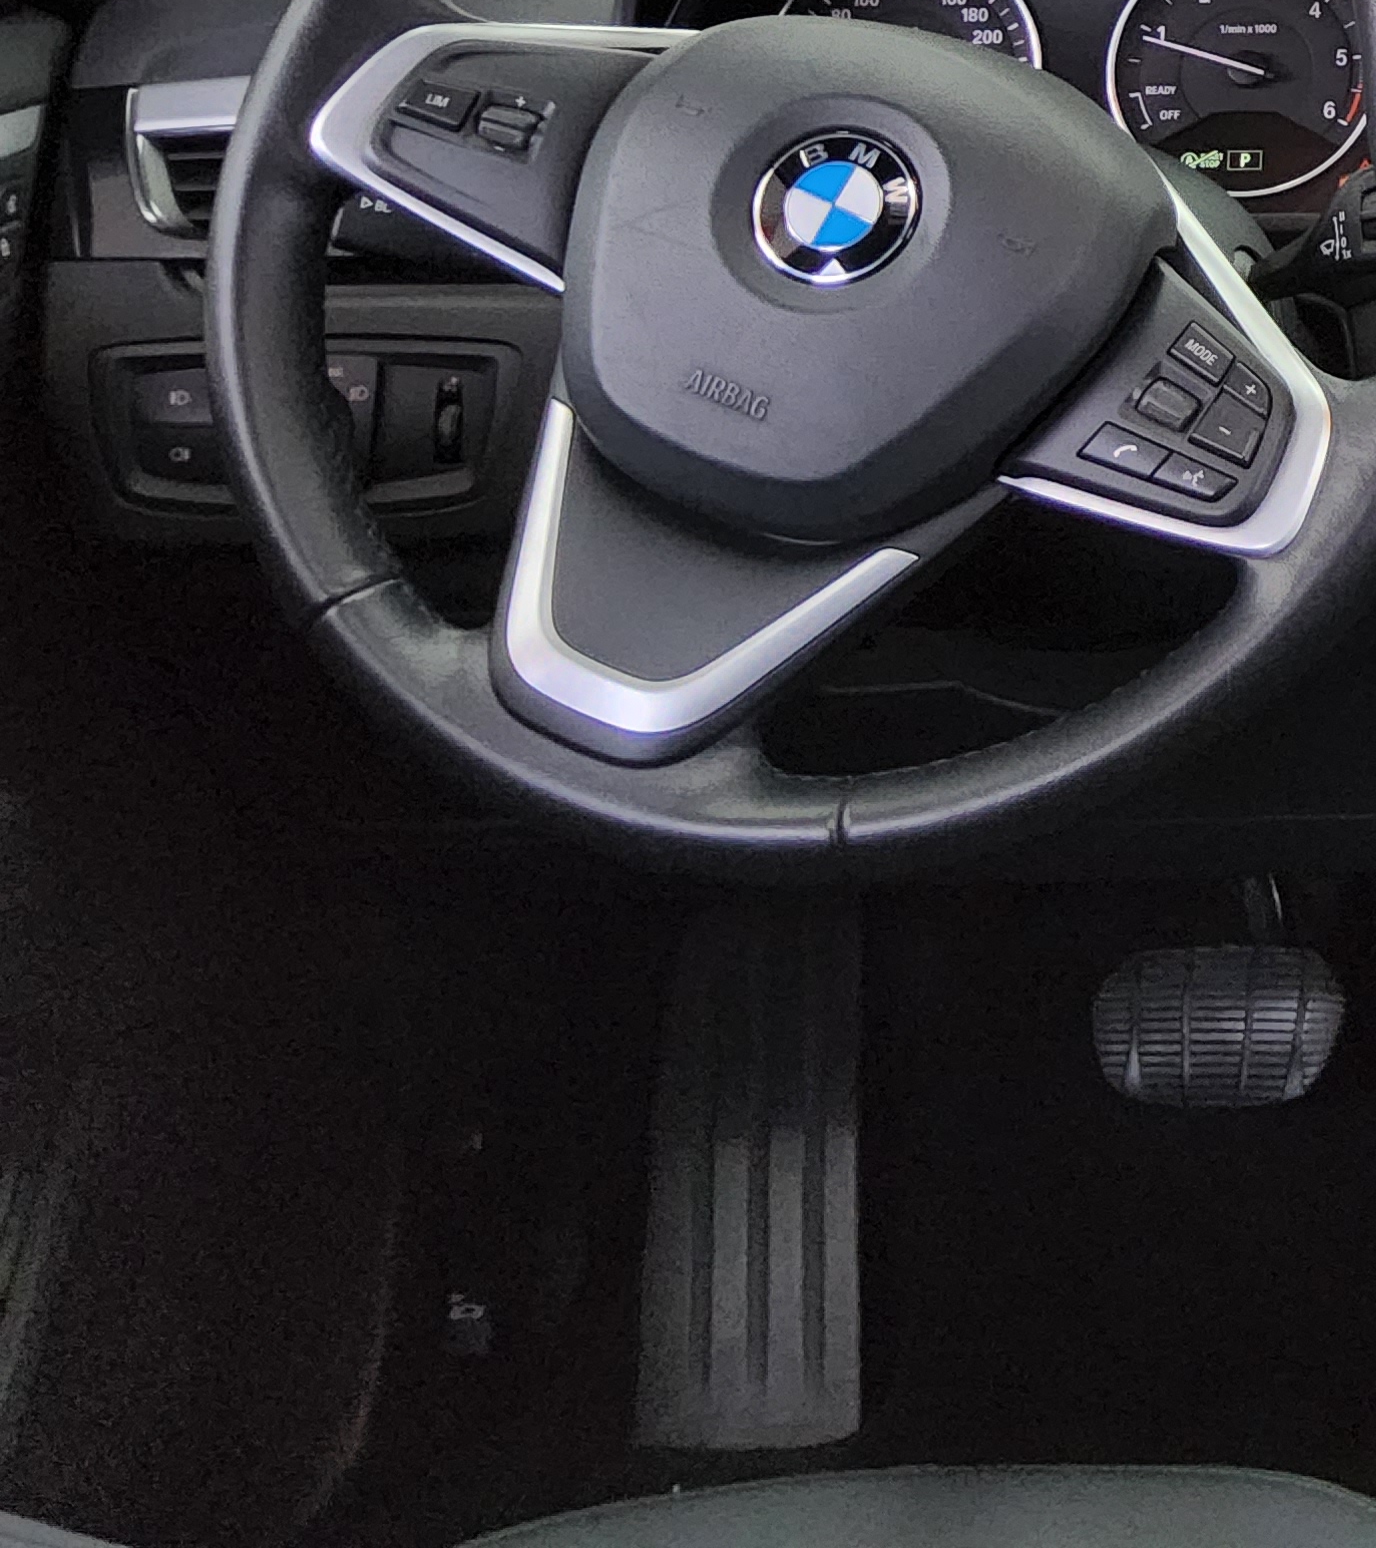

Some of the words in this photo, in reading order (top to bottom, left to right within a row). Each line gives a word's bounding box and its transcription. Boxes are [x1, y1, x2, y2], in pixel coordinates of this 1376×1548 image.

[961, 8, 989, 22] 180
[1309, 2, 1321, 18] 4
[1156, 25, 1166, 40] 1
[1219, 24, 1246, 34] 1/min
[1254, 24, 1277, 34] 1000
[972, 30, 1003, 45] 200
[1335, 49, 1348, 66] 5
[1145, 85, 1177, 95] READY
[425, 93, 450, 108] LIM
[1159, 110, 1181, 120] OFF
[1323, 101, 1336, 119] 6
[1240, 153, 1251, 168] P
[800, 142, 909, 204] BMW
[1184, 338, 1218, 366] MODE
[684, 369, 770, 421] AIRBAG
